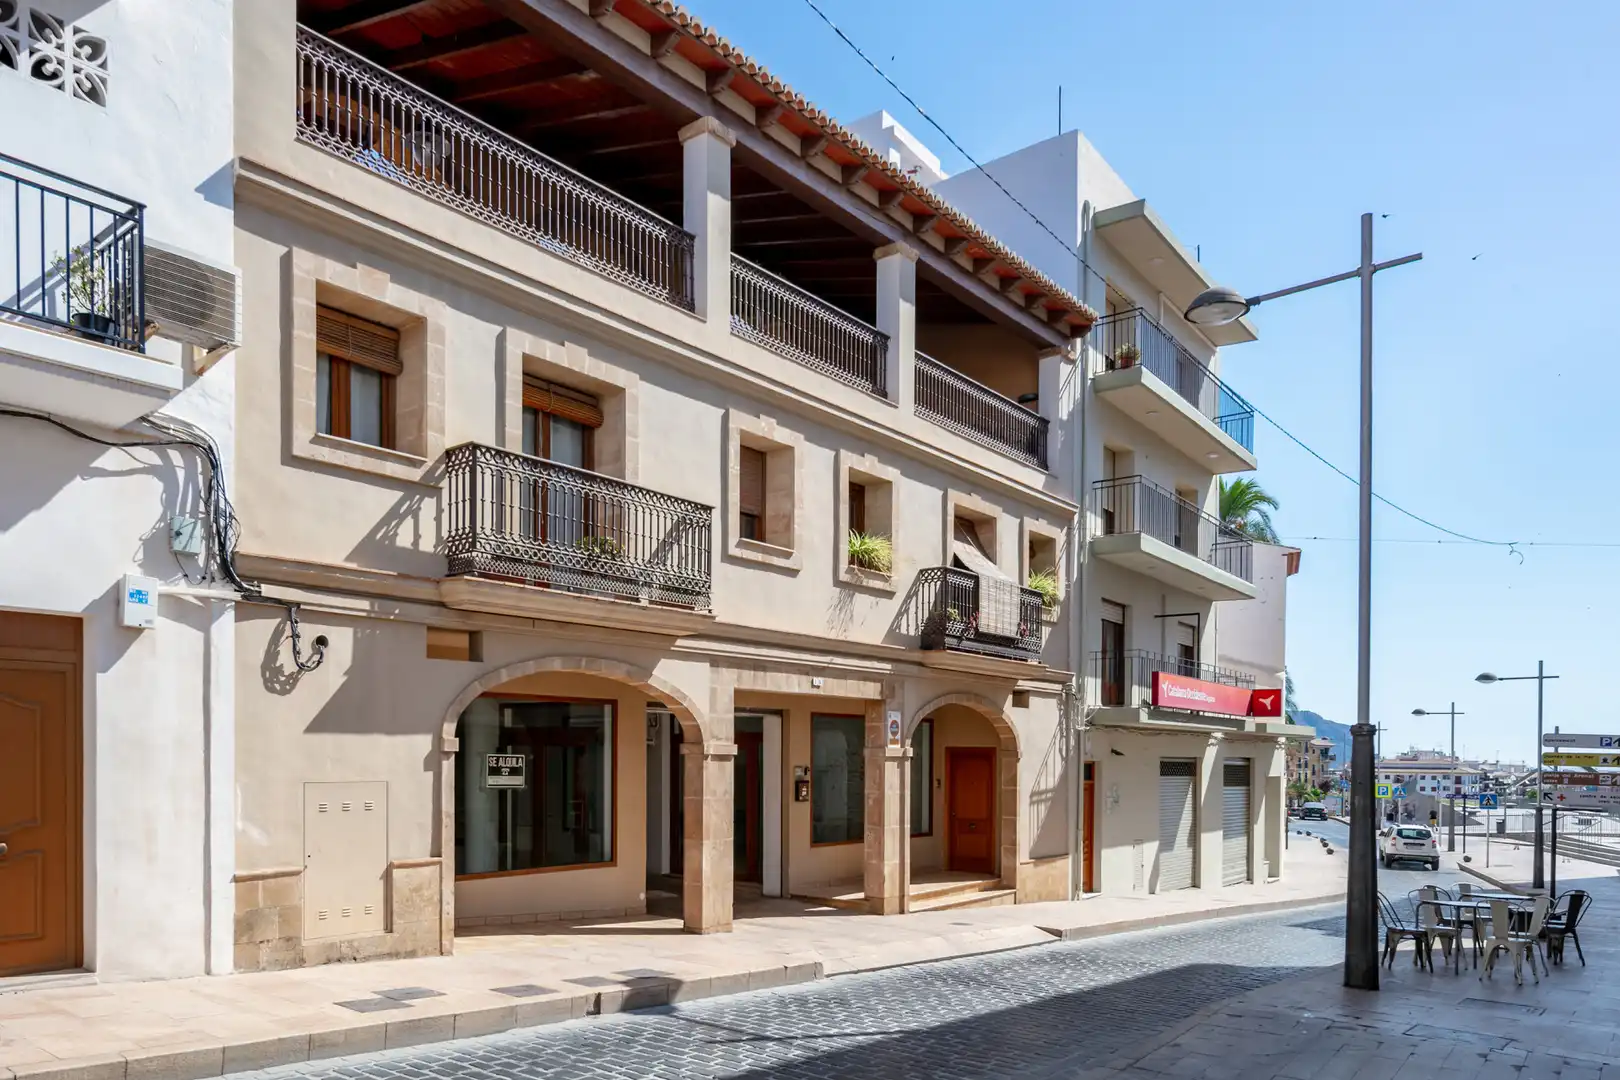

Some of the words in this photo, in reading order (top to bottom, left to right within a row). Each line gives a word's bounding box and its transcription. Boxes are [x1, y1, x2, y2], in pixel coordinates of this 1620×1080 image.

[1603, 737, 1611, 746] P
[488, 756, 498, 767] SE
[498, 757, 523, 767] ALQUILA
